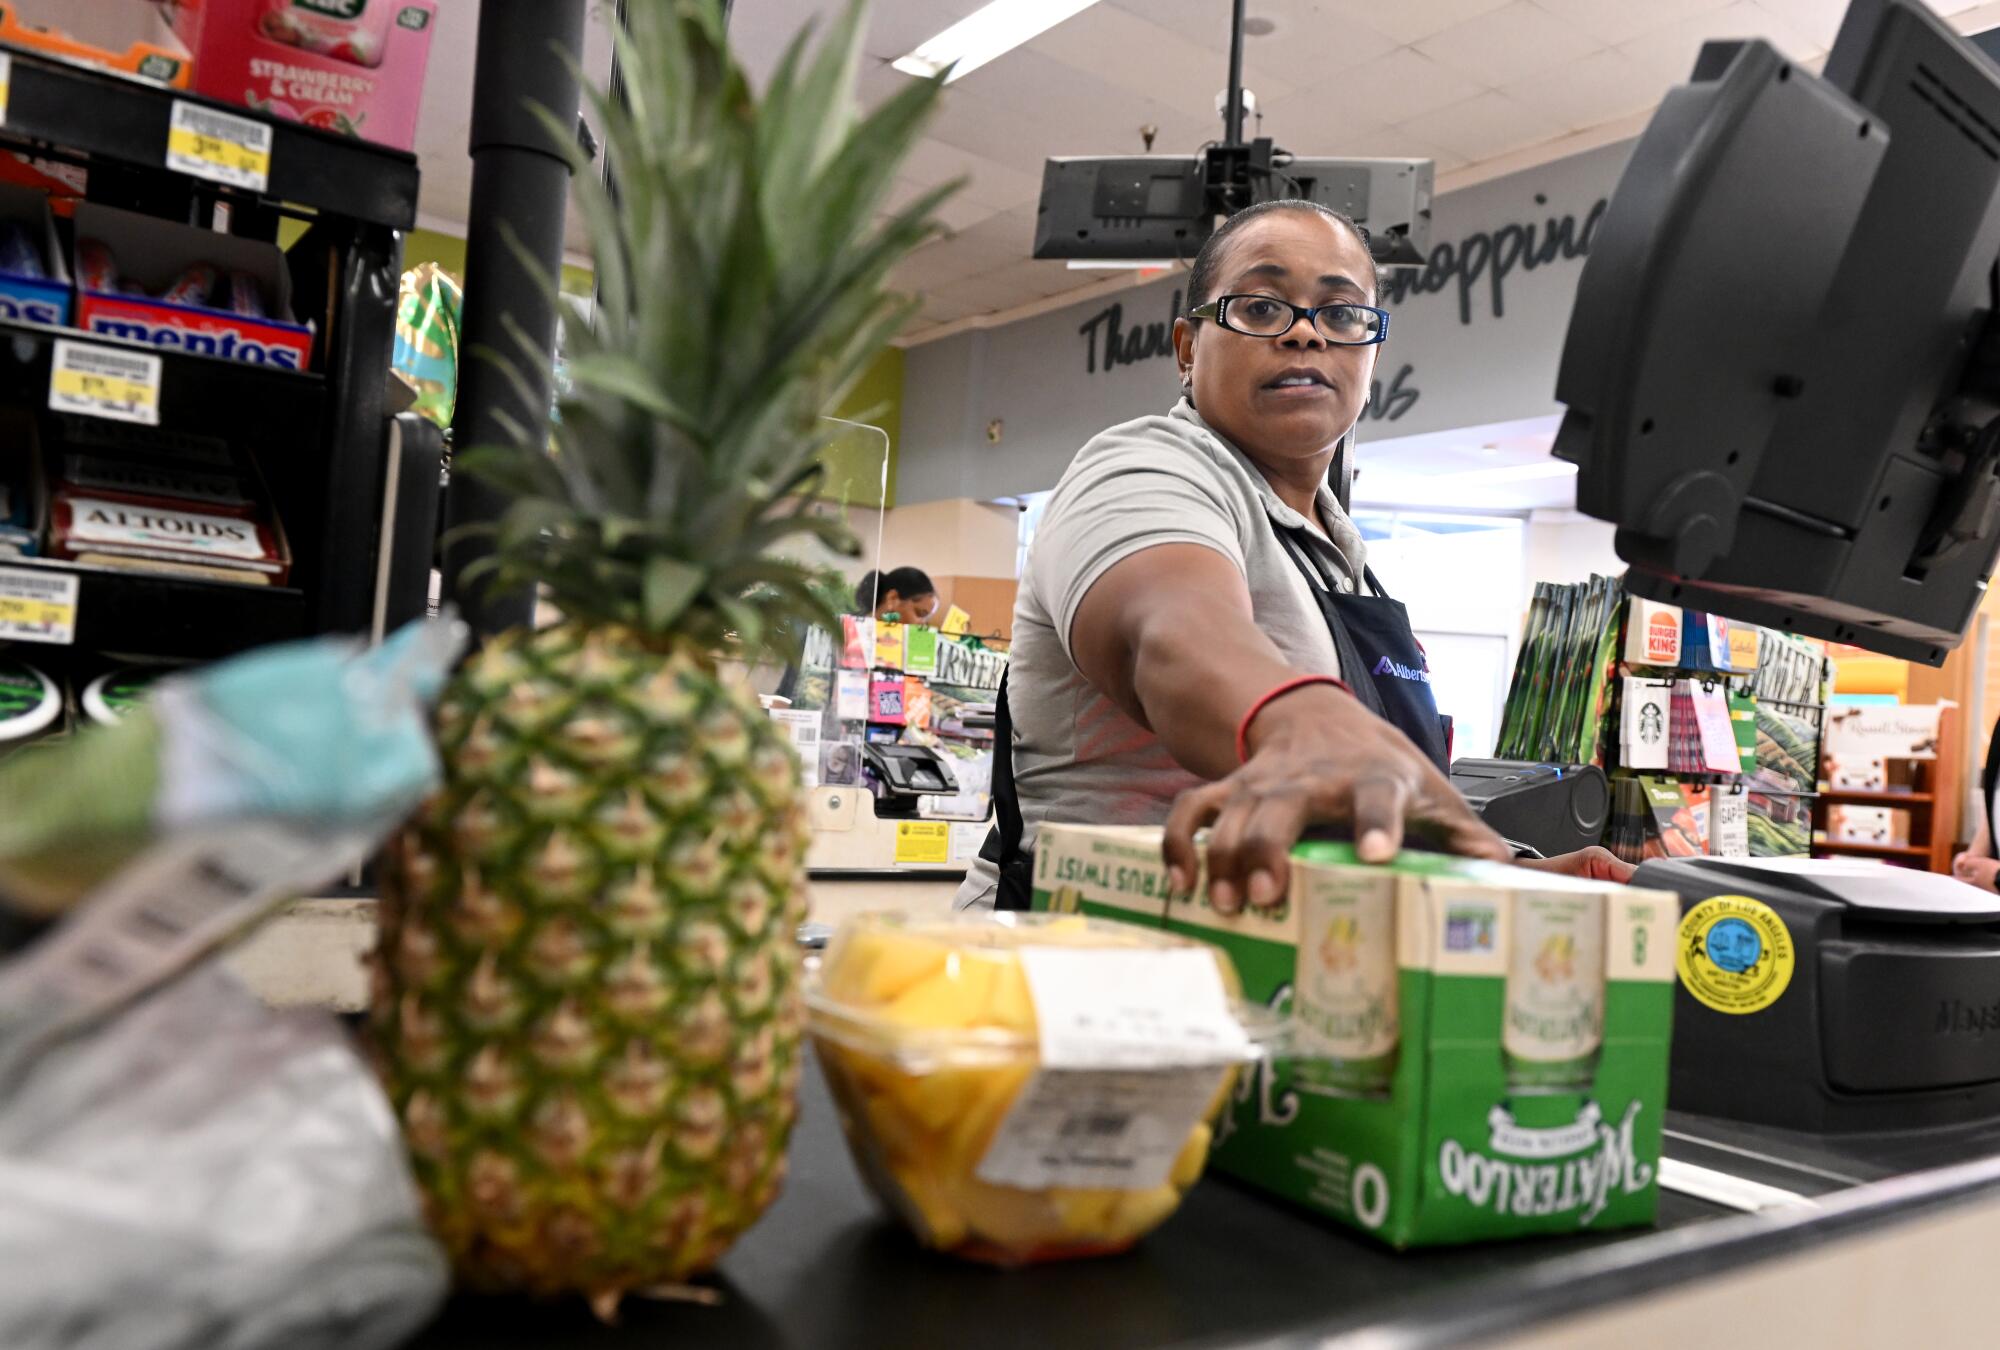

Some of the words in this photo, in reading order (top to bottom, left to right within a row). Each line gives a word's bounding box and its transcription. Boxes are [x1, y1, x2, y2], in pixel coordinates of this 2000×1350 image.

[250, 57, 374, 93] STRAWBERRY
[270, 78, 286, 97] &
[289, 82, 353, 104] CREAM
[1384, 194, 1607, 325] hoppin
[92, 318, 300, 370] mentos
[87, 508, 246, 542] ALTOIDS
[1649, 625, 1678, 639] BURGER
[1649, 637, 1677, 654] KING
[1055, 857, 1111, 890] TWIST
[1439, 1098, 1653, 1226] WATERLOO
